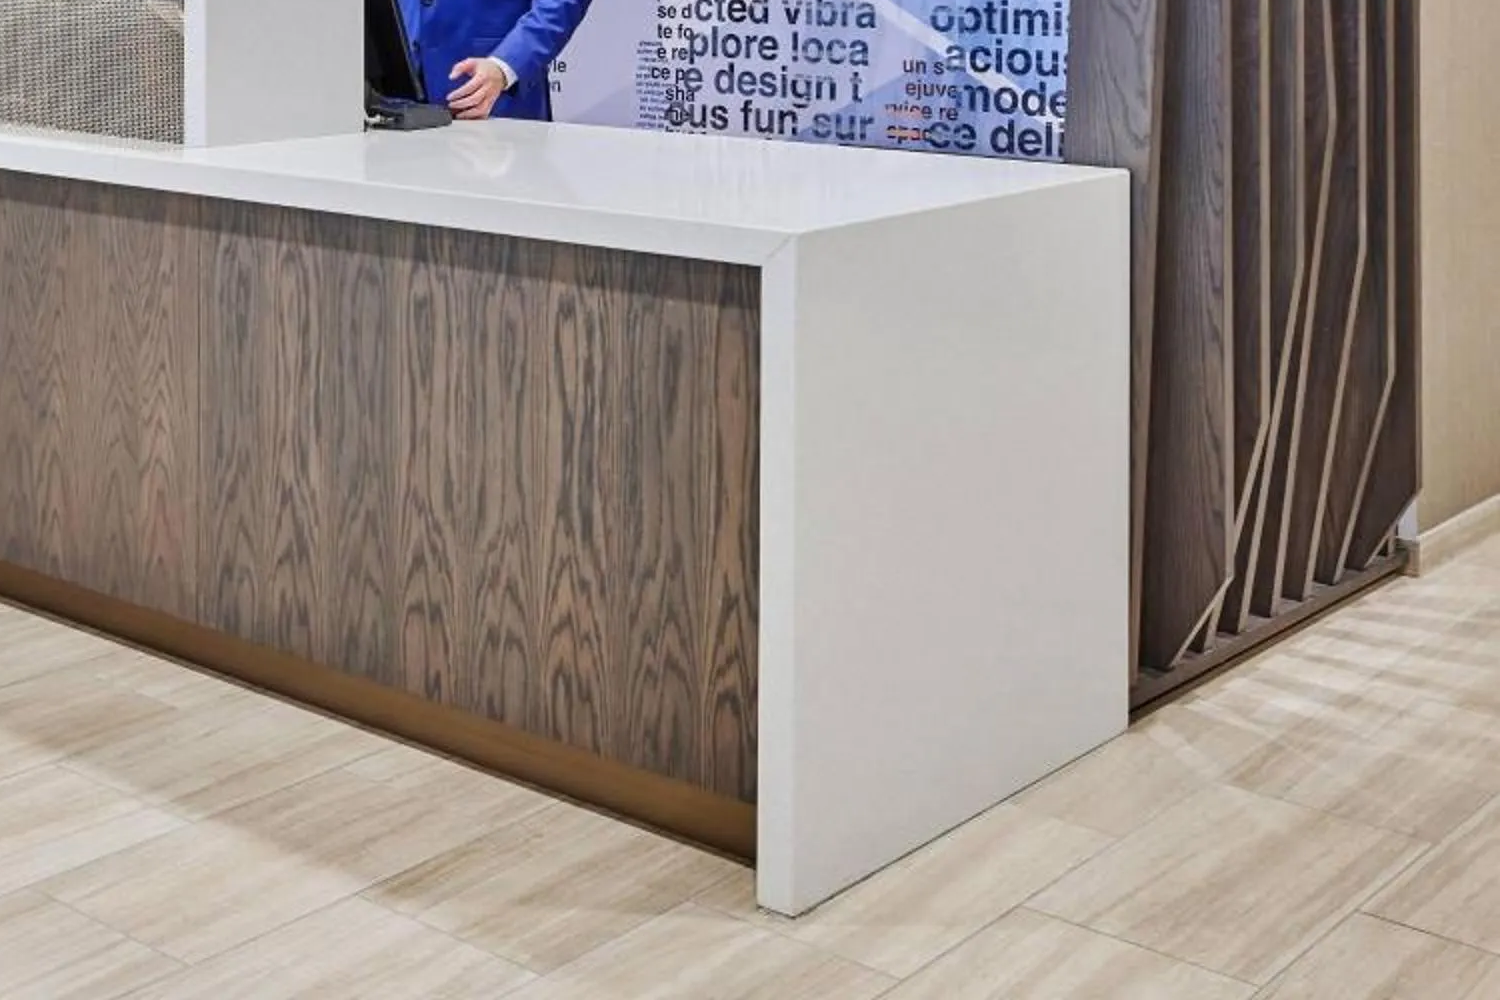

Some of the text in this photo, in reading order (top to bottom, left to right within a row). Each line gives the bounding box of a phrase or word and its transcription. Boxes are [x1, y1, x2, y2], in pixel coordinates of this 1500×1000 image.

[657, 3, 692, 19] se d
[929, 0, 1067, 37] optimi
[657, 23, 673, 38] te
[688, 27, 869, 66] plore loca
[945, 38, 1068, 77] aciou
[651, 66, 671, 81] ce
[902, 58, 945, 76] un s
[665, 85, 695, 102] sha
[714, 62, 836, 108] design
[740, 100, 799, 136] fun
[813, 111, 874, 140] sur
[939, 106, 959, 121] re
